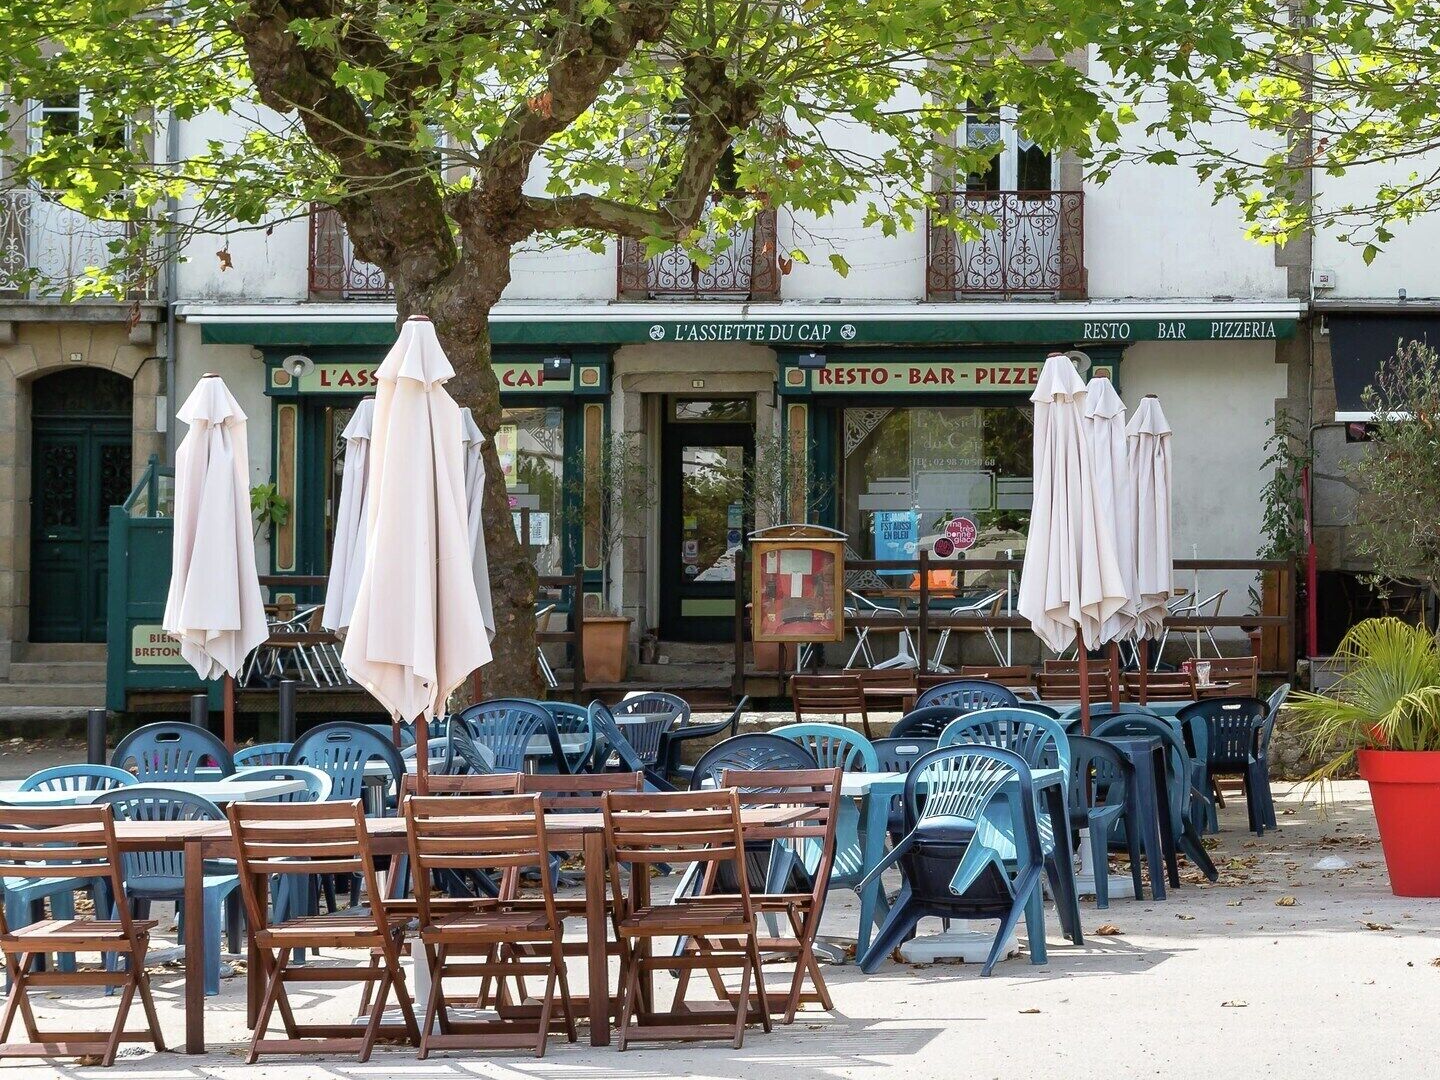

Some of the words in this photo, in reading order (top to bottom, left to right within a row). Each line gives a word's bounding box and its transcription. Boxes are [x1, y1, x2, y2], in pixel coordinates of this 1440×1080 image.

[674, 324, 765, 341] L'ASSIETTE
[769, 324, 795, 341] DU
[798, 324, 832, 341] CAP
[1083, 322, 1130, 339] RESTO
[1158, 322, 1187, 339] BAR
[1210, 321, 1277, 338] PIZZERIA
[320, 369, 379, 387] L'ASS
[819, 367, 889, 385] RESTO
[908, 367, 956, 385] BAR
[975, 367, 1038, 385] PIZZE
[135, 647, 180, 657] BRETON
